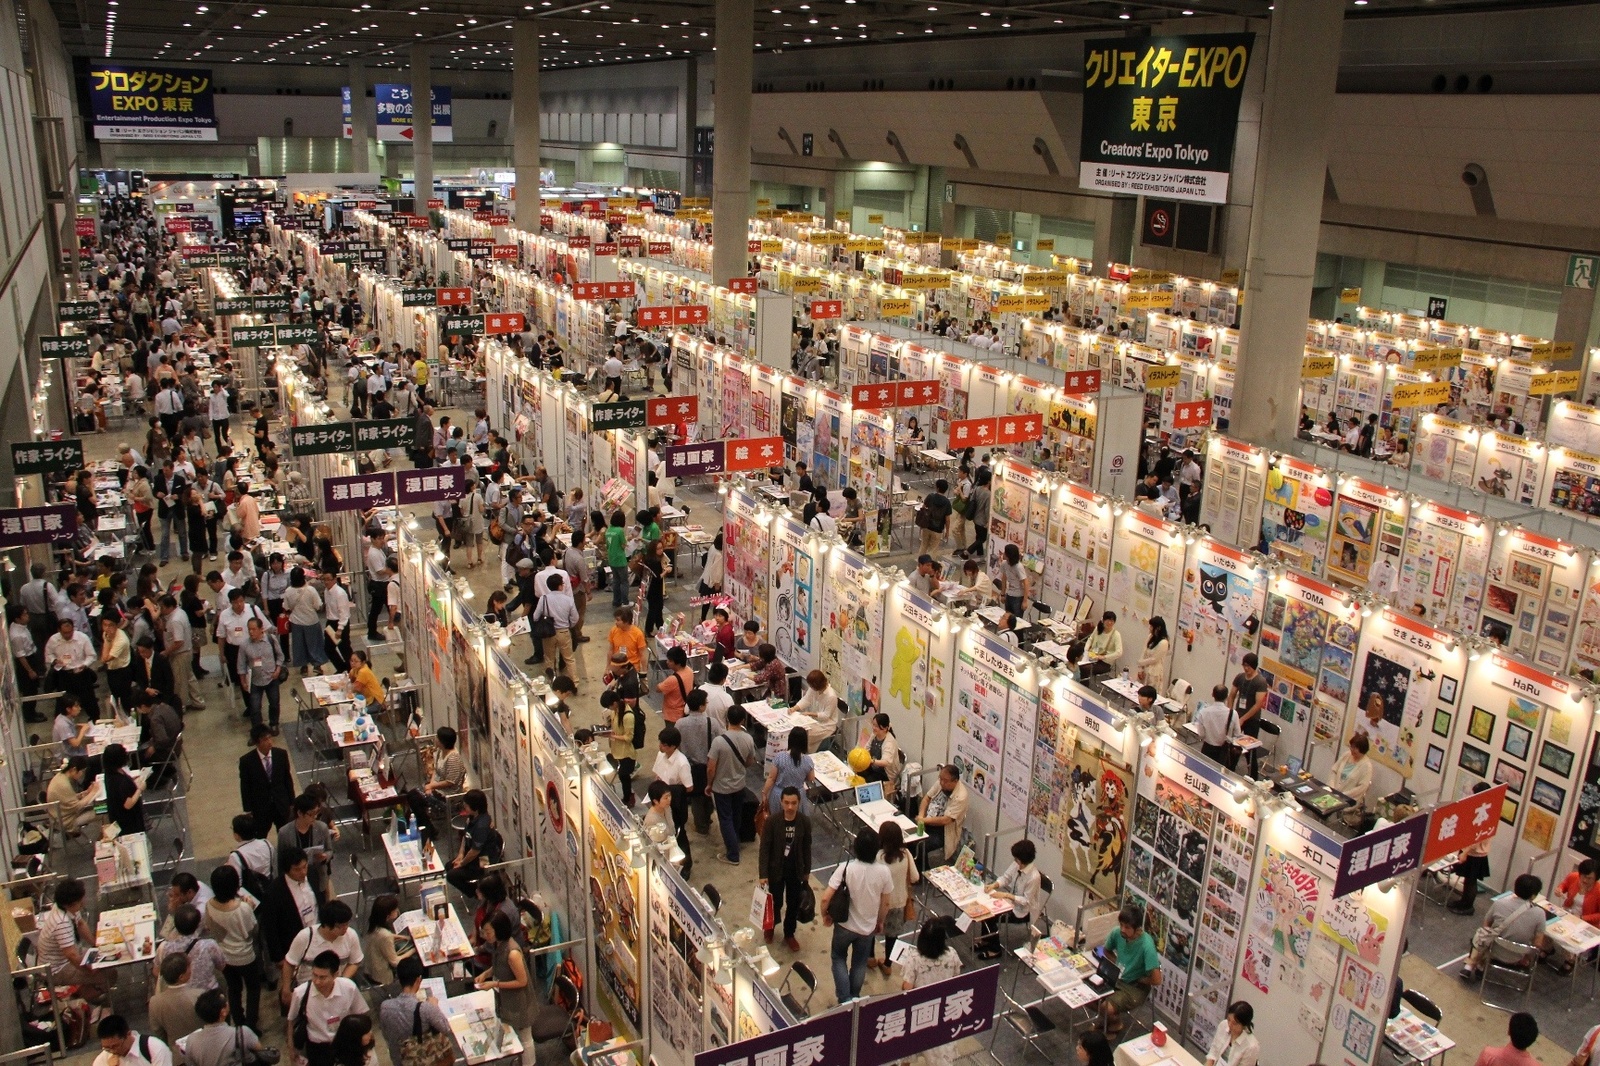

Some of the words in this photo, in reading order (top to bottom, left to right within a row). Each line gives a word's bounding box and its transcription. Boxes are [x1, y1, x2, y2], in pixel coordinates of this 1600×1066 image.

[1085, 45, 1248, 89] クリエイターEXPO
[91, 70, 209, 94] プロダクション
[112, 95, 158, 111] EXPO
[162, 97, 194, 112] 東京
[96, 114, 142, 122] Entertainment
[143, 115, 176, 123] Production
[1130, 95, 1179, 132] 東京
[1145, 143, 1172, 162] Expo
[1174, 144, 1209, 164] Tokyo
[1175, 186, 1194, 194] JAPAN
[595, 245, 617, 253] デザイナー
[733, 281, 753, 290] 絵本
[679, 309, 703, 319] 絵本
[816, 304, 837, 313] 絵本
[883, 302, 910, 310] イラストレーター
[491, 317, 518, 328] 絵本
[643, 311, 668, 320] 絵本
[233, 330, 273, 341] 作家・ライター
[41, 340, 87, 352] 作家・ライター
[1070, 375, 1095, 387] 絵本
[1148, 371, 1179, 381] イラストレーター
[858, 389, 889, 402] 絵本
[904, 385, 933, 398] 絵本
[1394, 390, 1421, 400] イラストレーター
[1423, 388, 1450, 399] イラストレーター
[595, 408, 645, 422] 作家・ライター
[655, 402, 690, 417] 絵本
[1180, 406, 1206, 420] 絵本
[358, 424, 413, 441] 作家・ライター
[956, 424, 989, 439] 絵本
[1005, 420, 1035, 434] 絵本
[294, 429, 351, 446] 作家・ライター
[14, 446, 81, 464] 作家・ライター
[672, 449, 714, 467] 漫画家
[735, 444, 774, 460] 絵本
[332, 481, 383, 500] 漫画家
[405, 474, 455, 493] 漫画家
[372, 498, 391, 506] ゾーン
[444, 491, 462, 499] ゾーン
[2, 514, 63, 534] 漫画家
[1143, 526, 1155, 536] noa
[51, 532, 74, 541] ゾーン
[1522, 543, 1556, 559] 山本久美子
[1213, 554, 1237, 570] いだゆみ
[1301, 588, 1325, 606] TOMA
[1392, 626, 1408, 640] せき
[1409, 635, 1433, 651] ともみ
[973, 646, 1015, 678] やましたゆきお
[1512, 677, 1541, 697] HaRu
[1084, 716, 1100, 733] 明加
[1184, 771, 1211, 797] 杉山実
[1438, 802, 1492, 841] 絵本
[1475, 826, 1495, 841] ゾーン
[1302, 845, 1323, 865] 木口
[1348, 831, 1412, 877] 漫画家
[1392, 857, 1415, 874] ゾーン
[1334, 903, 1357, 923] まんが
[875, 988, 974, 1044] 漫画家
[950, 1018, 985, 1039] ゾーン
